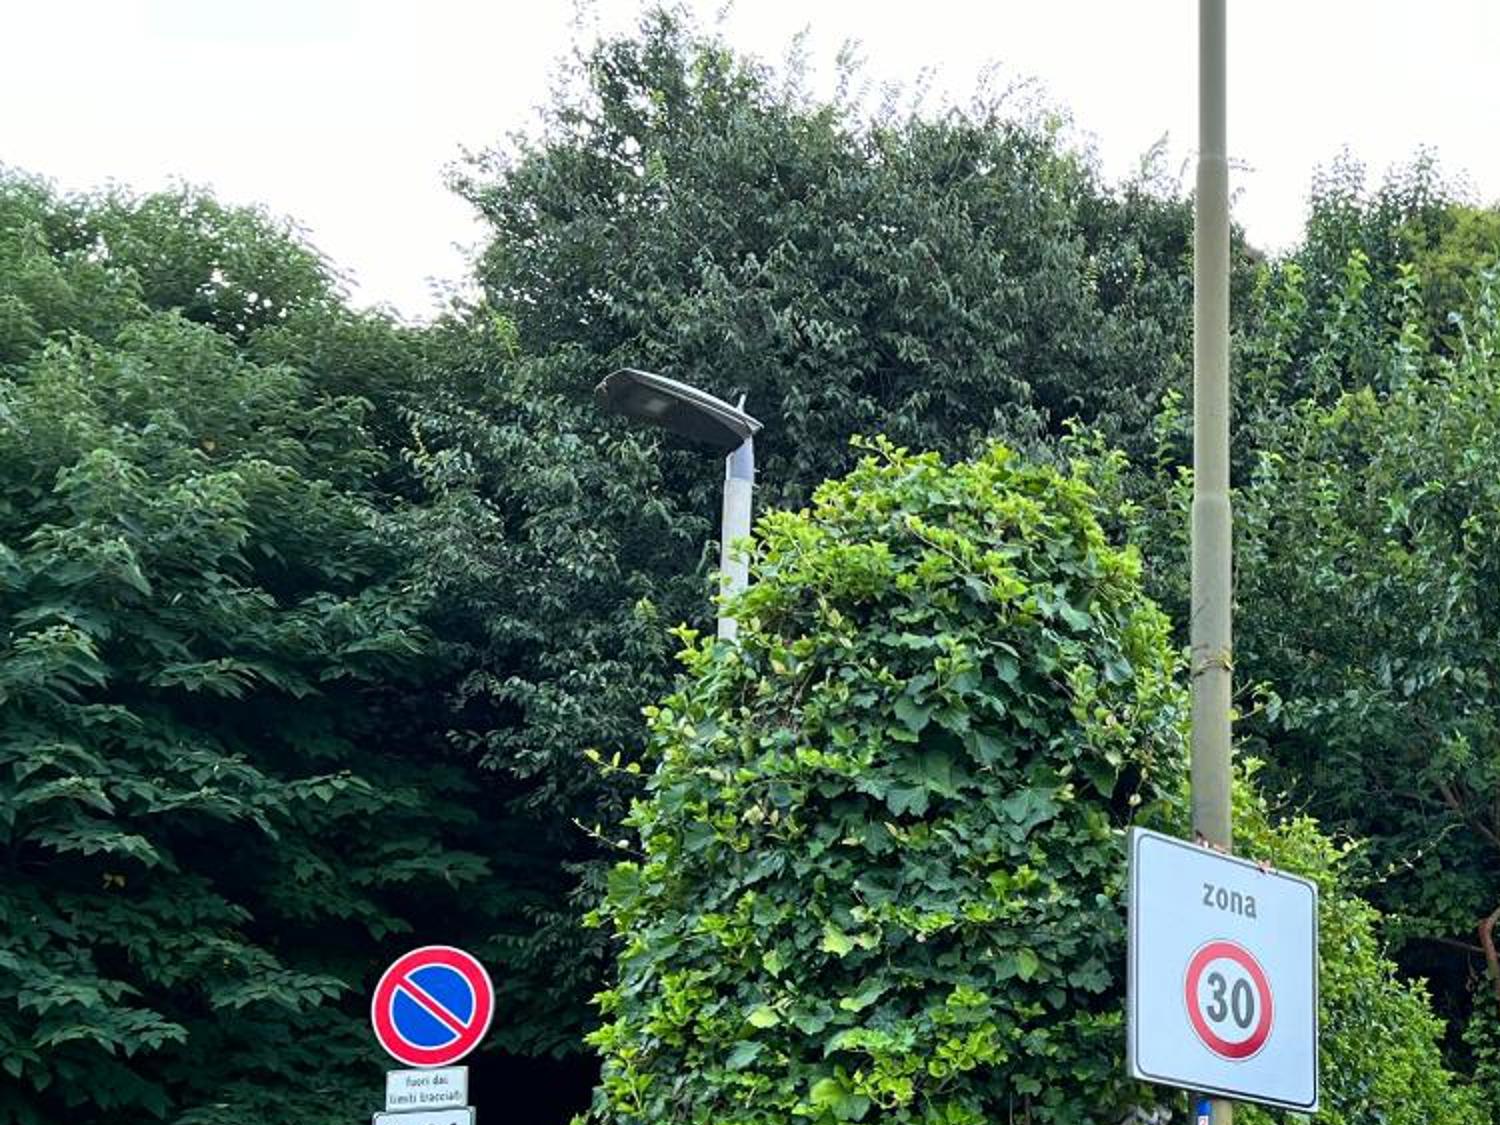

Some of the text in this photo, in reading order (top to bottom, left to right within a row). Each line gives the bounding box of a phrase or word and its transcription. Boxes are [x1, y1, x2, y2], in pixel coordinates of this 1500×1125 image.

[1203, 882, 1257, 919] zona
[1206, 972, 1255, 1030] 30
[406, 1076, 430, 1087] fuori
